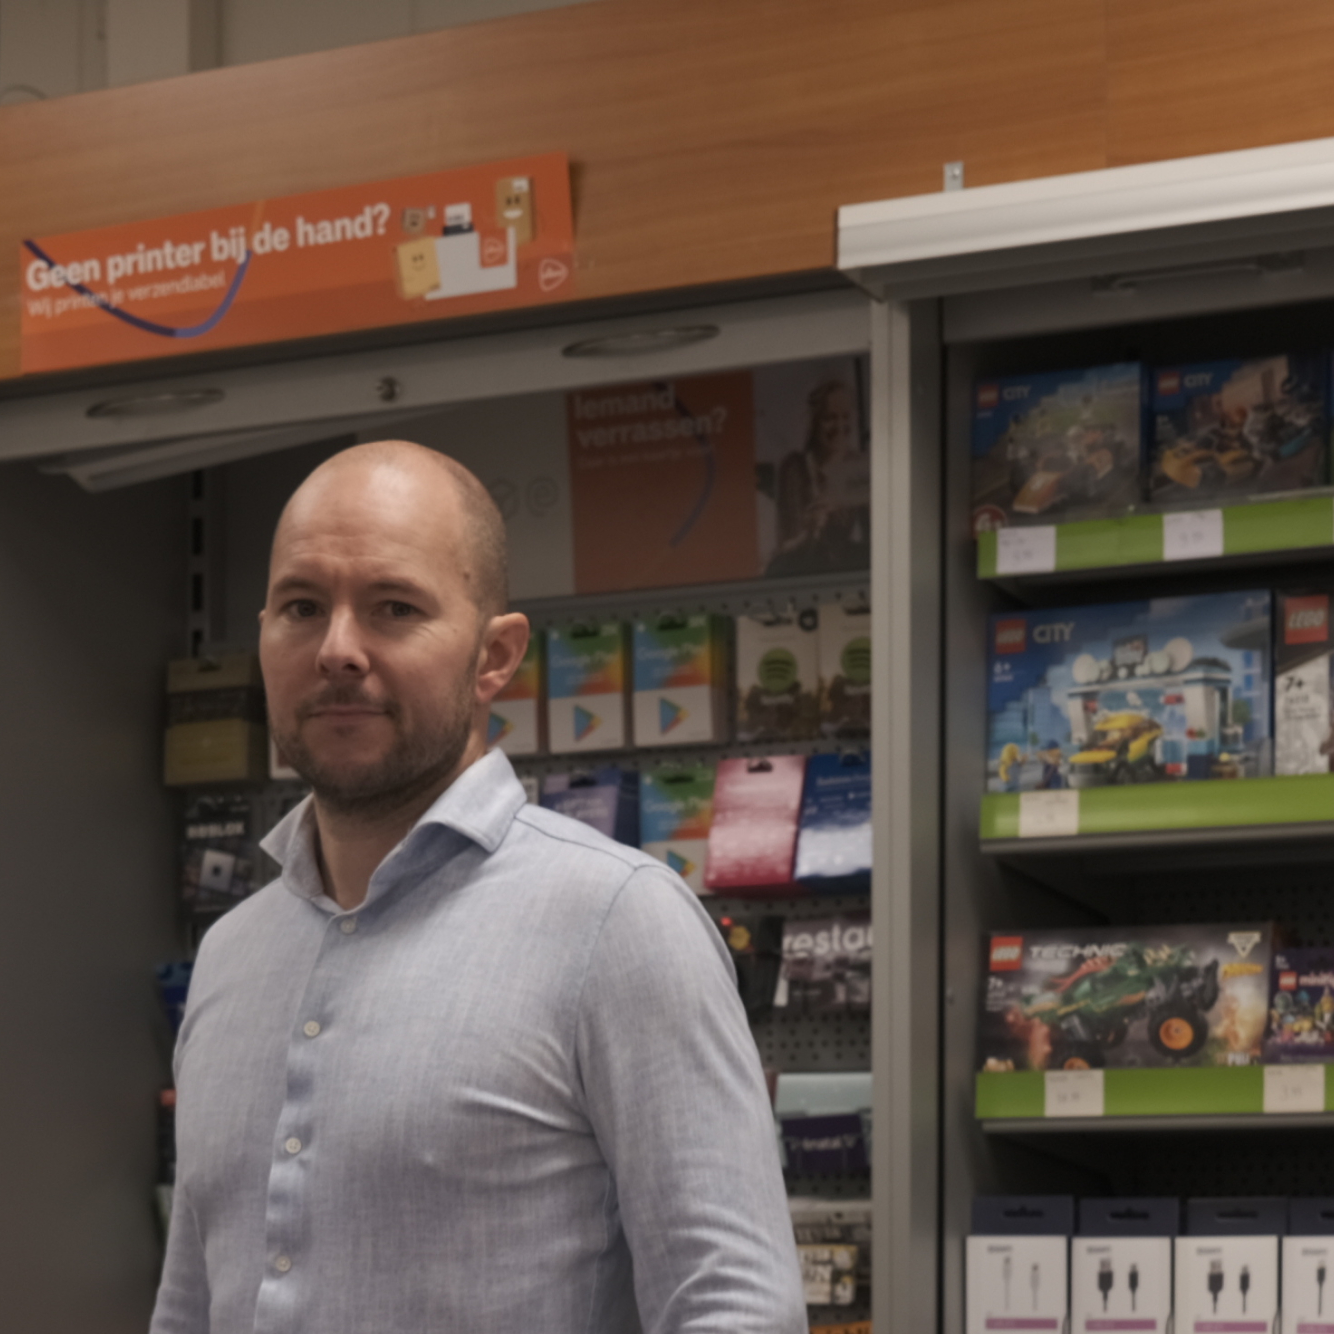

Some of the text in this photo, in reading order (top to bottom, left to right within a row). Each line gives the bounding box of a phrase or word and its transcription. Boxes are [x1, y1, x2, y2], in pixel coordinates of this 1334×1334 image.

[26, 201, 392, 292] Geen printer bij de hand?
[127, 270, 227, 301] verzendlabel
[1184, 372, 1214, 387] CITY
[574, 383, 676, 420] Iemand
[1002, 385, 1032, 399] CITY
[576, 405, 729, 448] verrassen?
[1286, 608, 1325, 631] LEGO
[1033, 622, 1074, 642] CITY
[1284, 676, 1305, 691] 7+
[1029, 942, 1128, 959] TECHNIC
